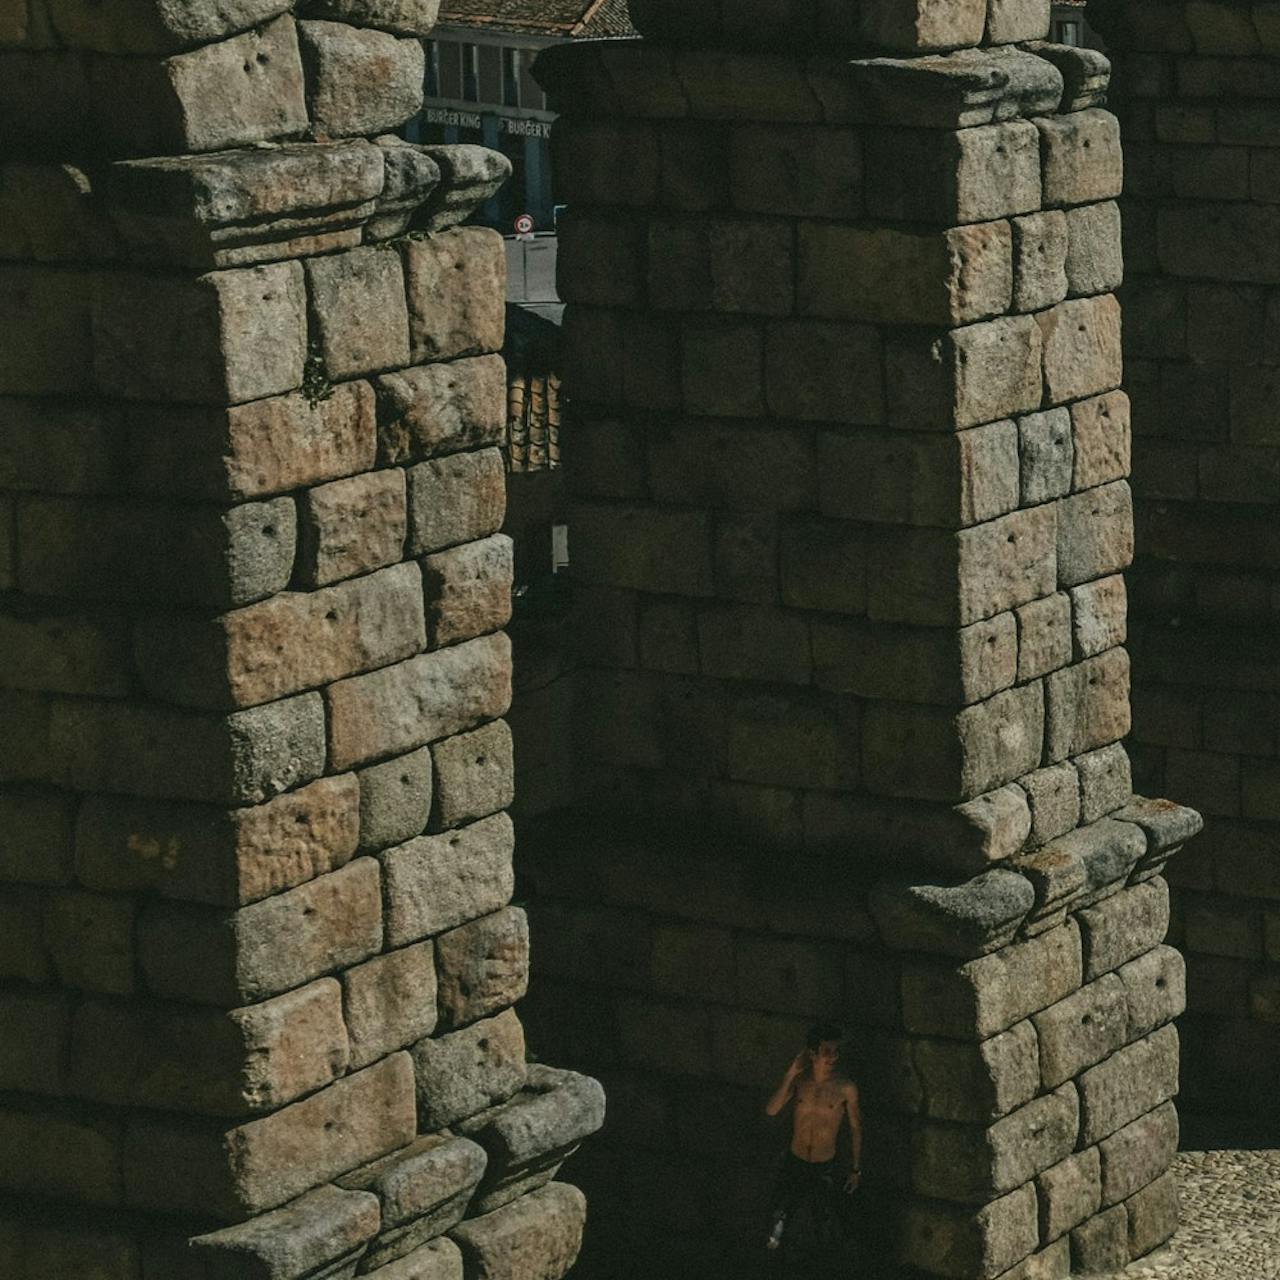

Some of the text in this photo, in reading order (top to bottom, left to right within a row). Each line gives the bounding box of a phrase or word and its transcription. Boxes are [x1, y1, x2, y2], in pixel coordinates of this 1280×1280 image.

[427, 110, 481, 129] BURGER KING
[508, 120, 542, 137] BURGER
